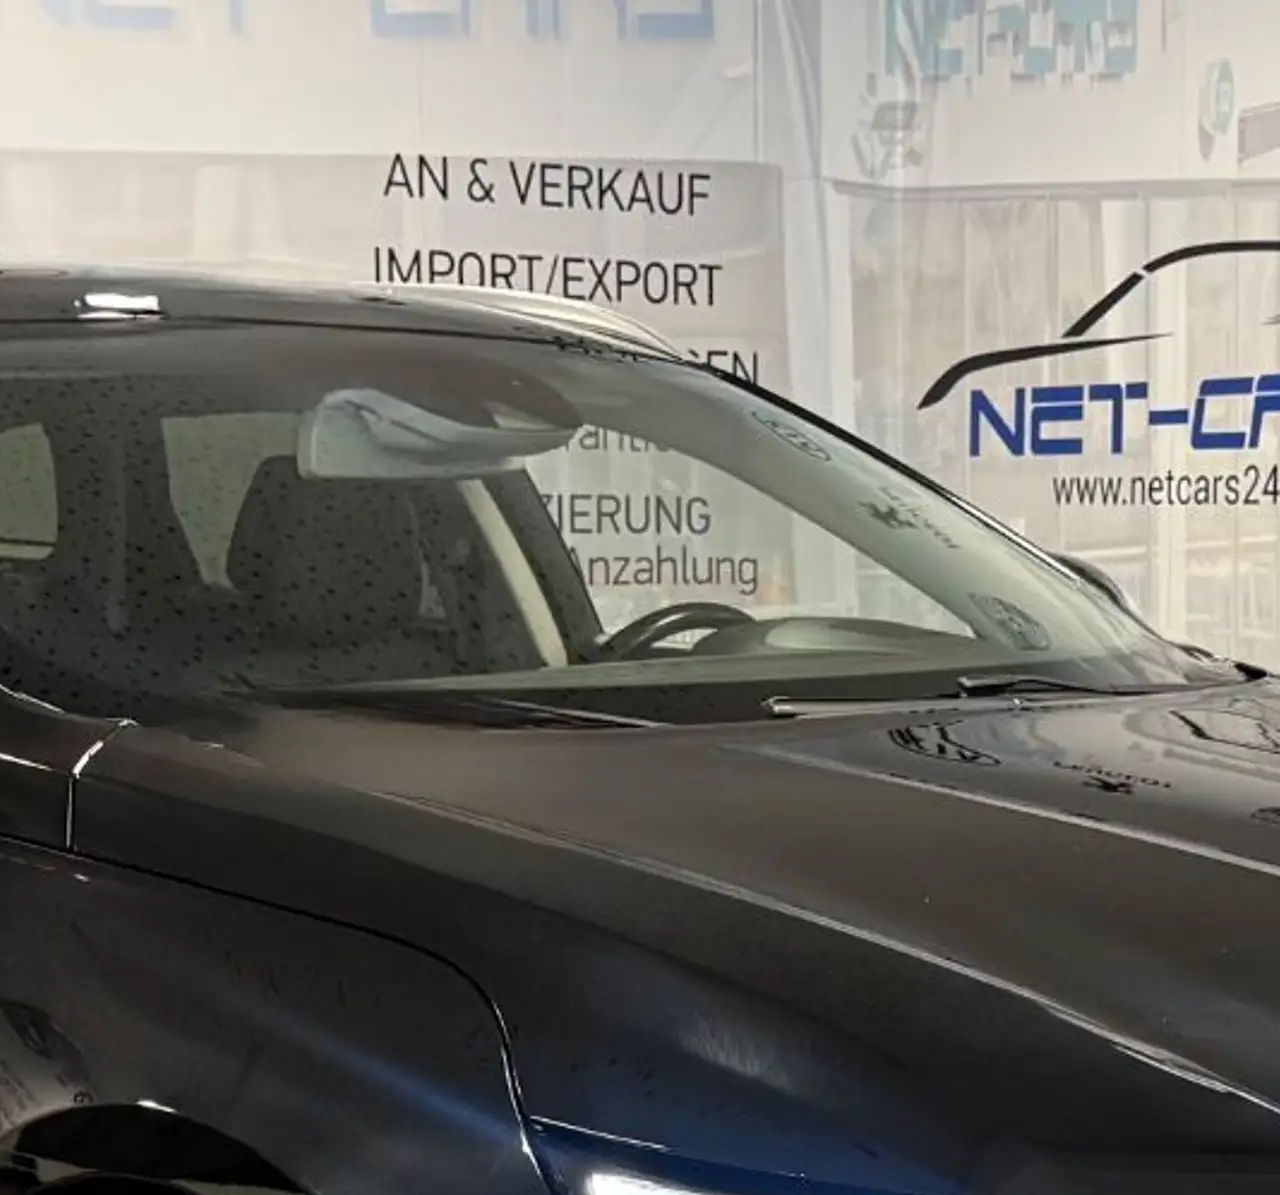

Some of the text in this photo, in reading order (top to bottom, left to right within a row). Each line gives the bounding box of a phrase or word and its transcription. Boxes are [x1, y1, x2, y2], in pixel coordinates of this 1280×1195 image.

[383, 153, 711, 217] AN & VERKAUF
[374, 246, 724, 307] IMPORT/EXPORT
